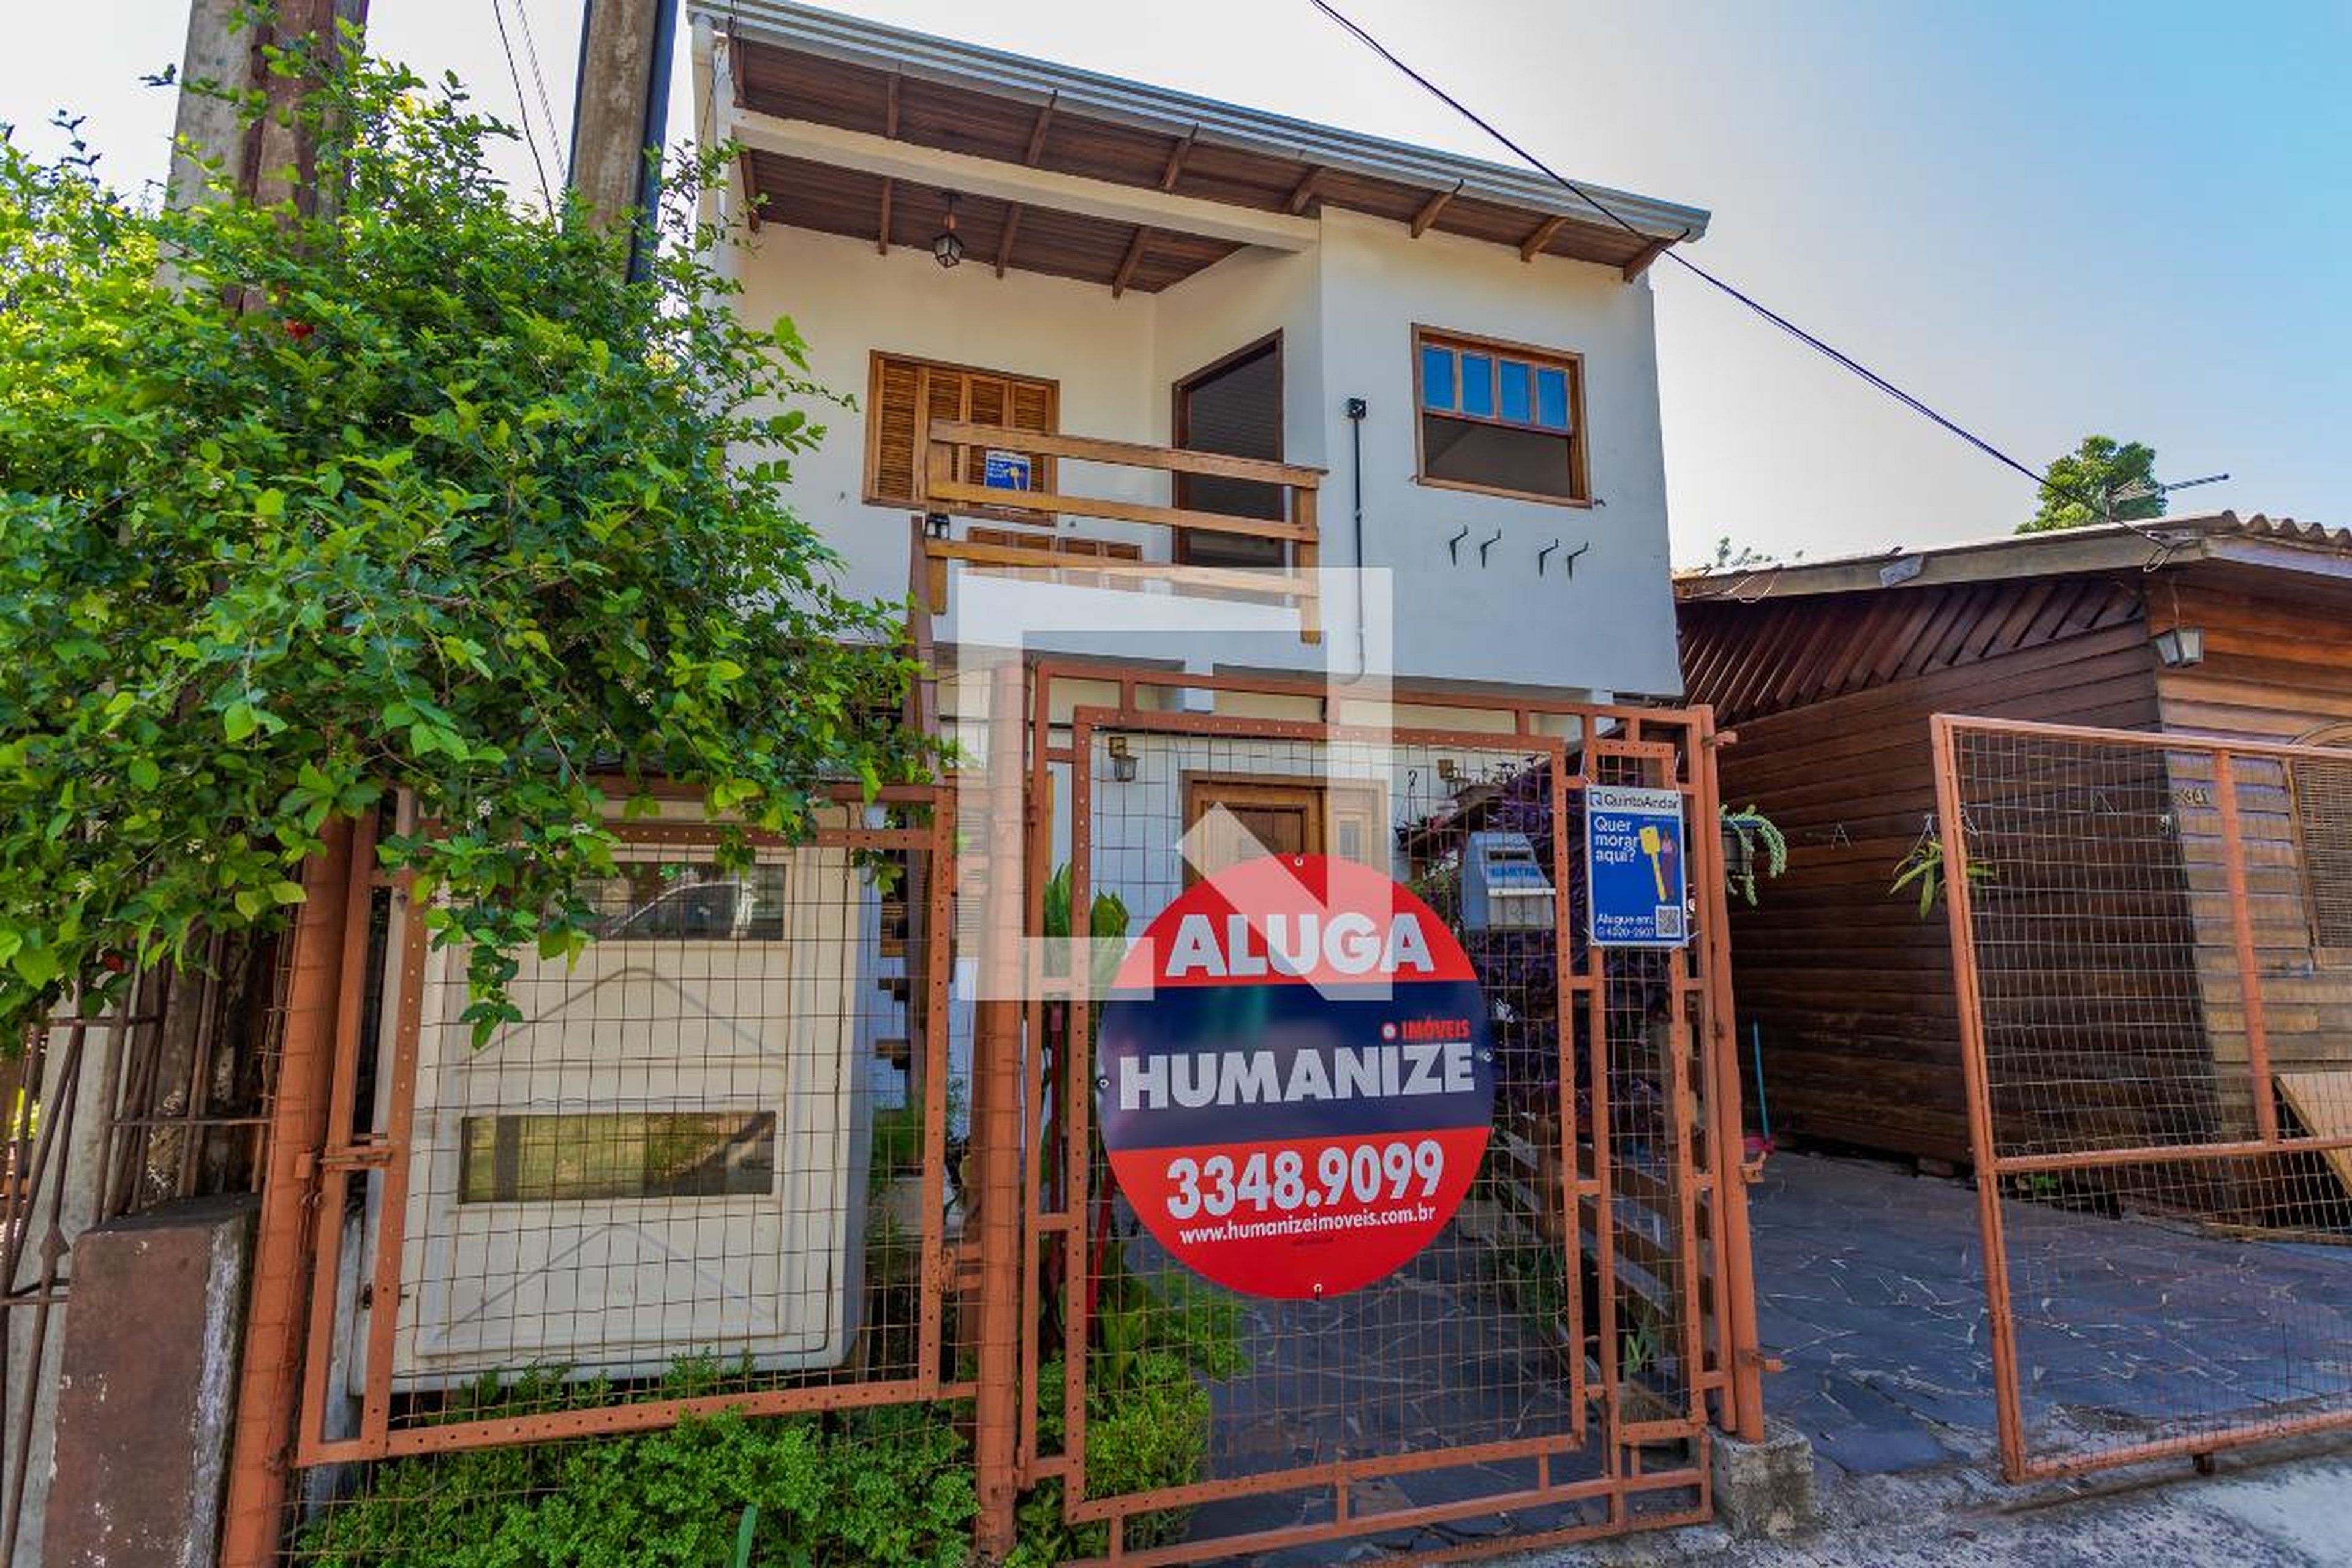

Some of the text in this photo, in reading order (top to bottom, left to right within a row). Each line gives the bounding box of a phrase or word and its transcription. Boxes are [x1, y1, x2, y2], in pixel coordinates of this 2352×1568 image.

[1604, 794, 1678, 809] QuintoAndar
[1594, 816, 1632, 832] Quer
[1595, 835, 1640, 847] morar
[1596, 848, 1636, 864] aqui?
[1166, 913, 1434, 977] ALUGA
[1401, 1014, 1470, 1039] IMÓVEIS
[1120, 1043, 1475, 1111] HUMANIZE
[1166, 1140, 1444, 1220] 3348.9099
[1180, 1203, 1436, 1245] www.humanizeimoveis.com.br
